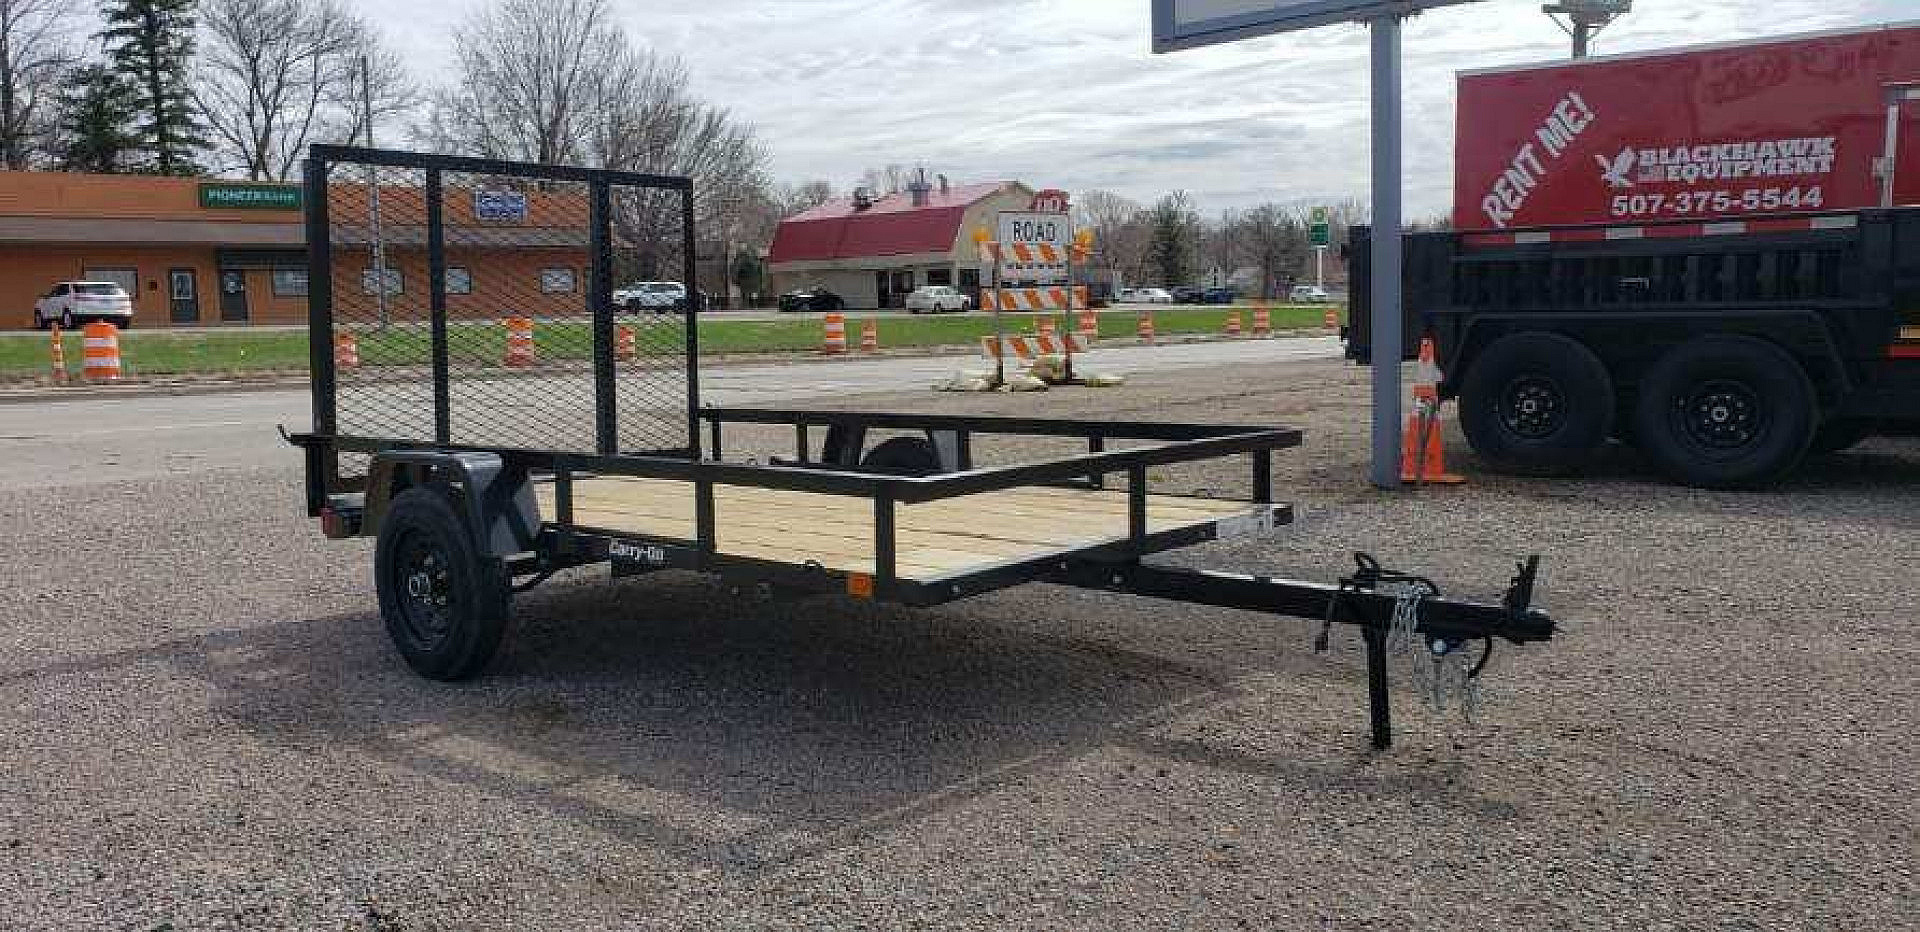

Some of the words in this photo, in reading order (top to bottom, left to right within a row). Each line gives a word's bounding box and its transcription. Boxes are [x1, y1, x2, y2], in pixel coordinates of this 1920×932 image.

[1482, 143, 1546, 228] RENT
[1535, 92, 1596, 157] ME!
[1638, 137, 1836, 166] BLACKHAWK
[1667, 154, 1834, 183] EQUIPMENT
[1611, 186, 1823, 216] 507-375-5544
[1013, 221, 1056, 242] ROAD
